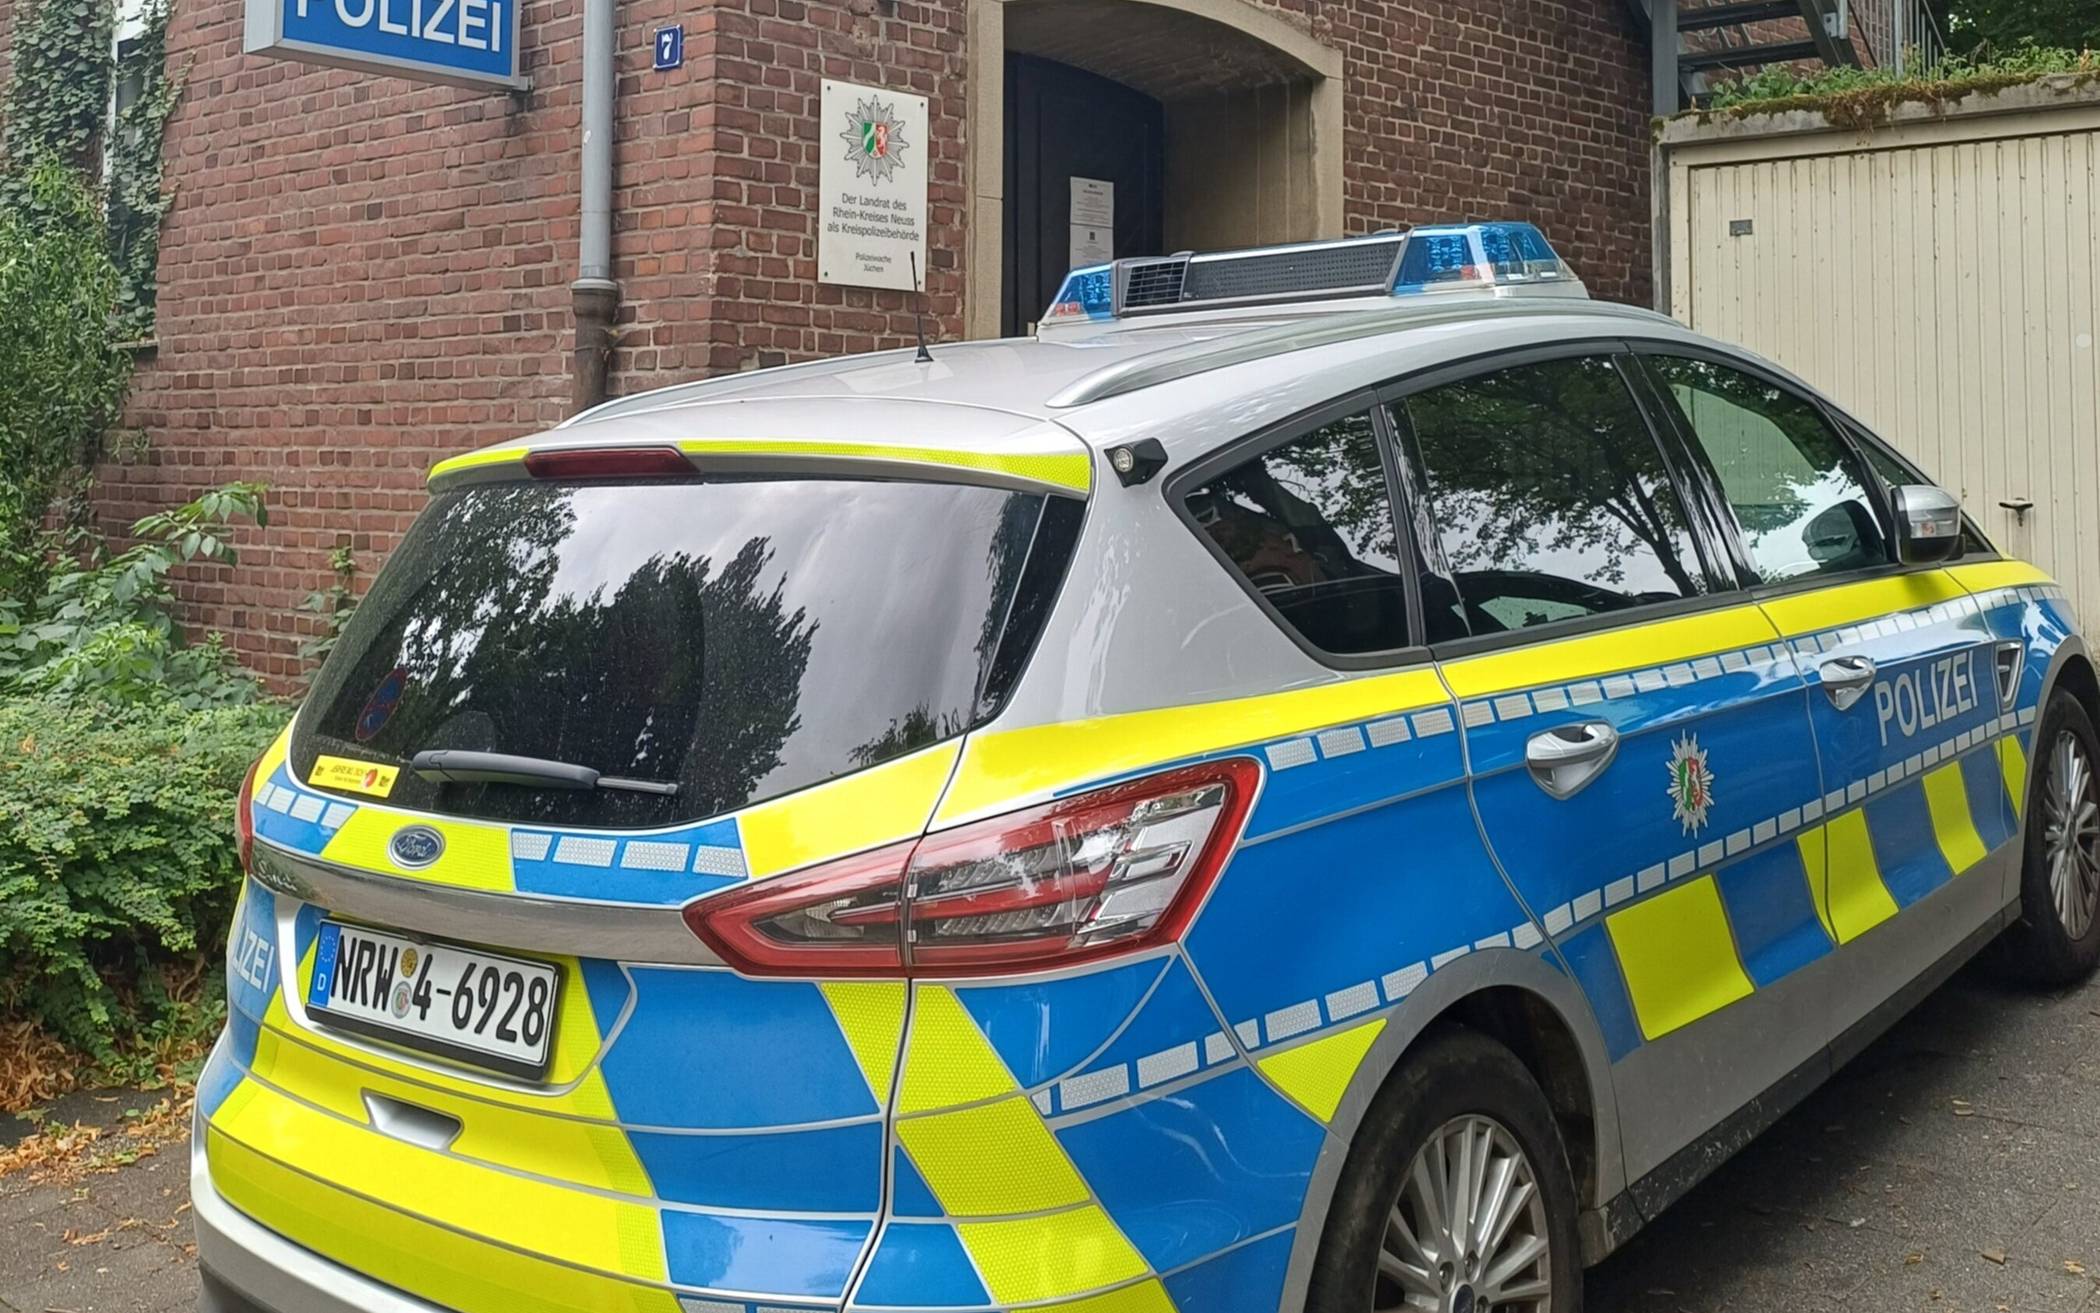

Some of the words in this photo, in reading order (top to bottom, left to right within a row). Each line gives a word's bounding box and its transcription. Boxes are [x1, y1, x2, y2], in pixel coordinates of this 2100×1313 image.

[661, 32, 673, 60] 7
[842, 193, 856, 204] Der
[859, 196, 890, 208] Landrat
[892, 200, 906, 211] des
[833, 207, 888, 223] Rhein-Kreises
[890, 214, 914, 226] Neuss
[827, 221, 840, 233] als
[841, 223, 919, 241] Kreispolizeibehörde
[1874, 650, 1979, 747] POLIZEI
[316, 973, 327, 991] D
[330, 935, 399, 1012] NRW
[412, 953, 549, 1047] 4-6928
